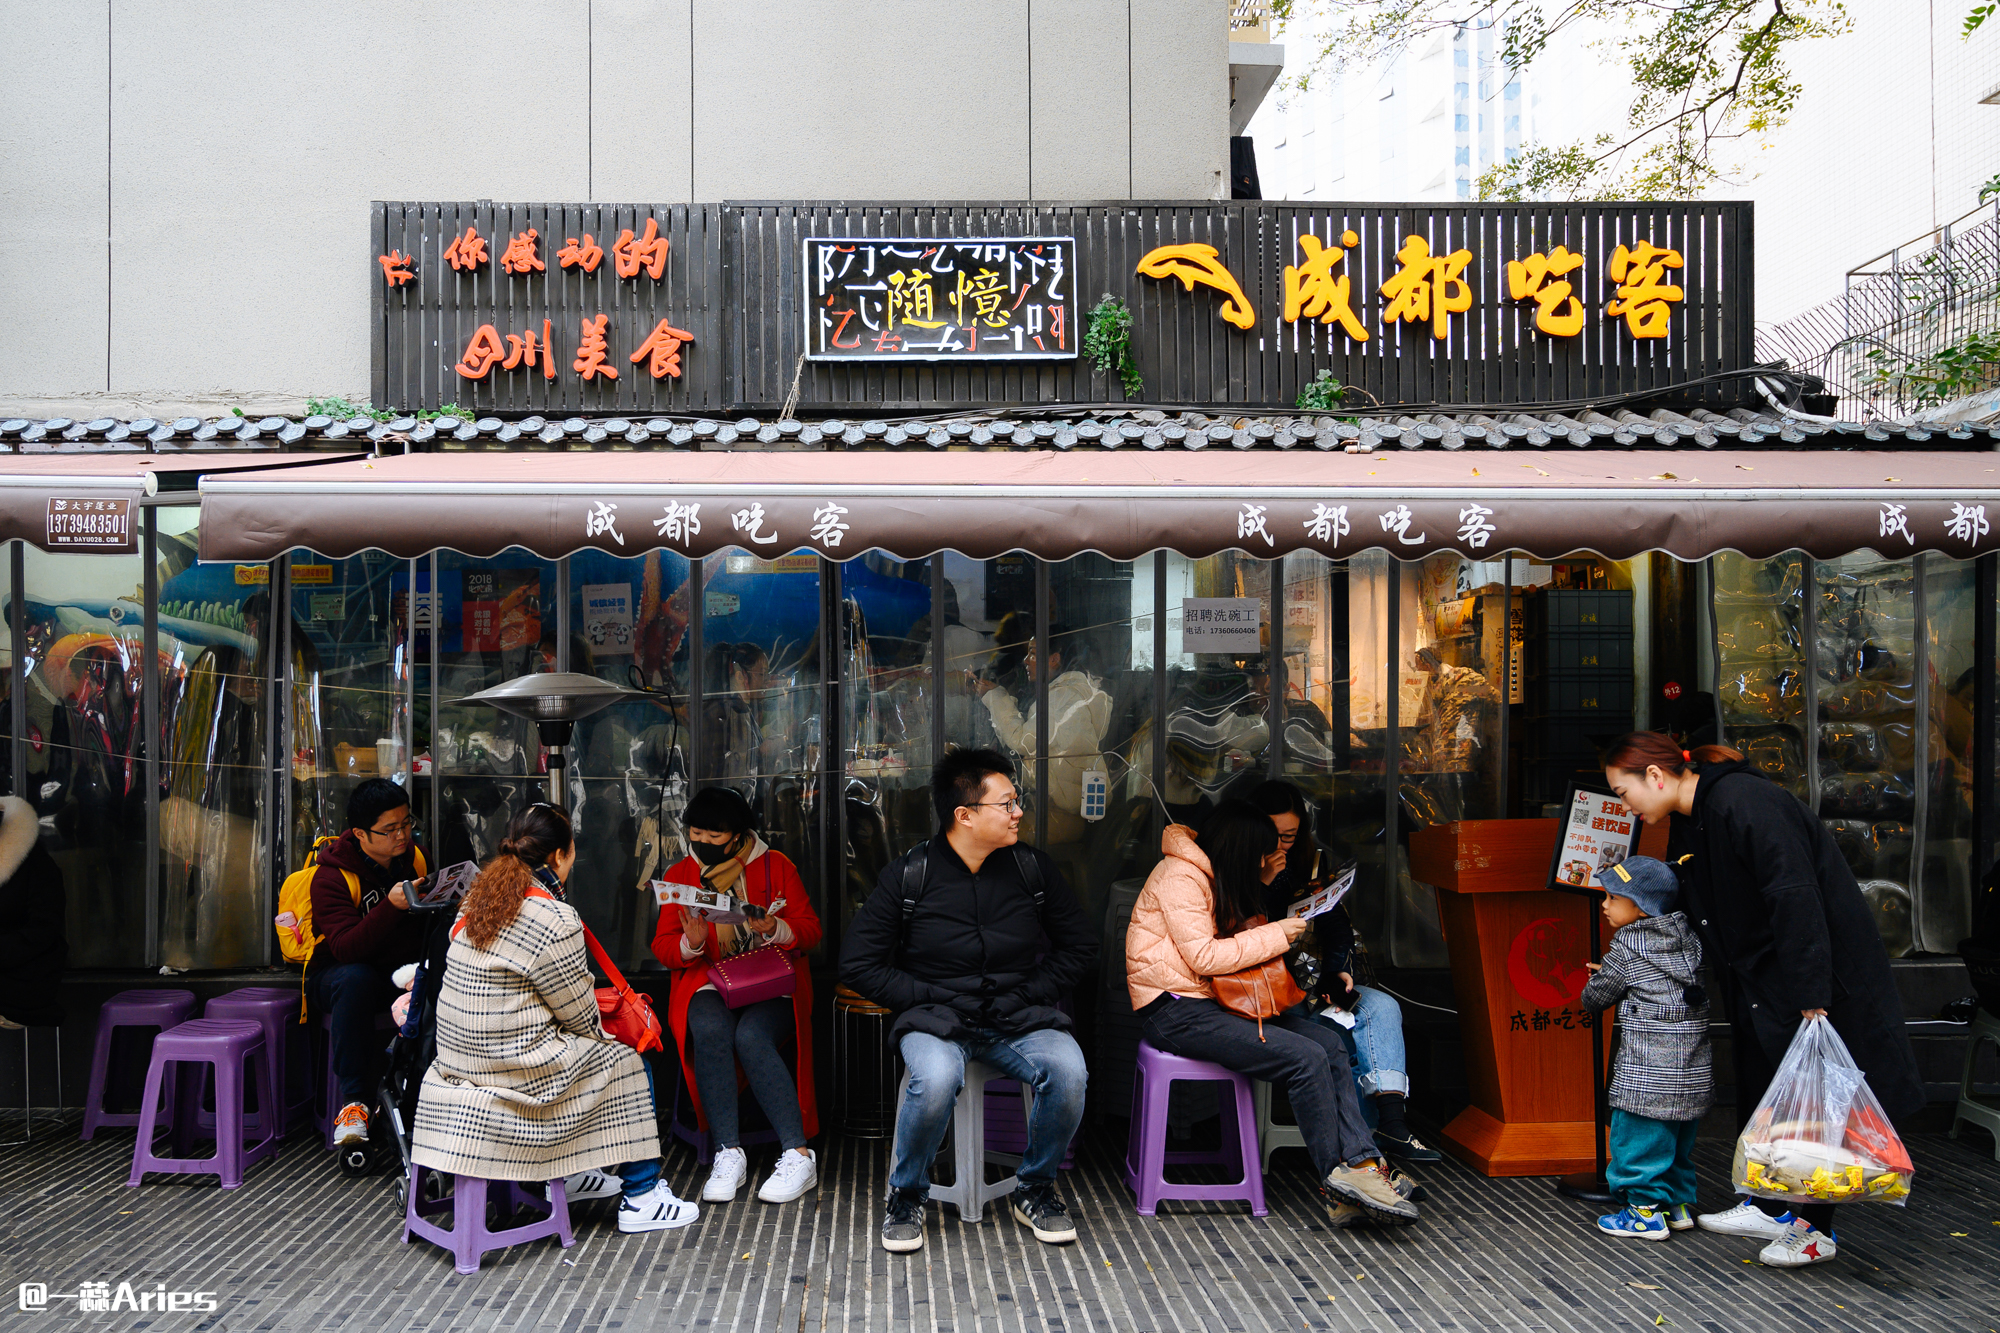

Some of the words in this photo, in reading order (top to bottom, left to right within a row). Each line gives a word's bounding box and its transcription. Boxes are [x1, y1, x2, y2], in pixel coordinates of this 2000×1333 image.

[1284, 229, 1685, 342] 成都吃客
[49, 513, 126, 534] 13739483501
[586, 500, 850, 548] 成都吃客
[1237, 503, 1496, 549] 成都吃客
[1880, 502, 1990, 548] 成都
[468, 574, 493, 584] 2018
[1185, 608, 1255, 622] 招聘洗碗工
[1664, 685, 1681, 697] 外12
[1592, 817, 1631, 835] 送饮品
[1510, 1008, 1593, 1032] 成都吃客
